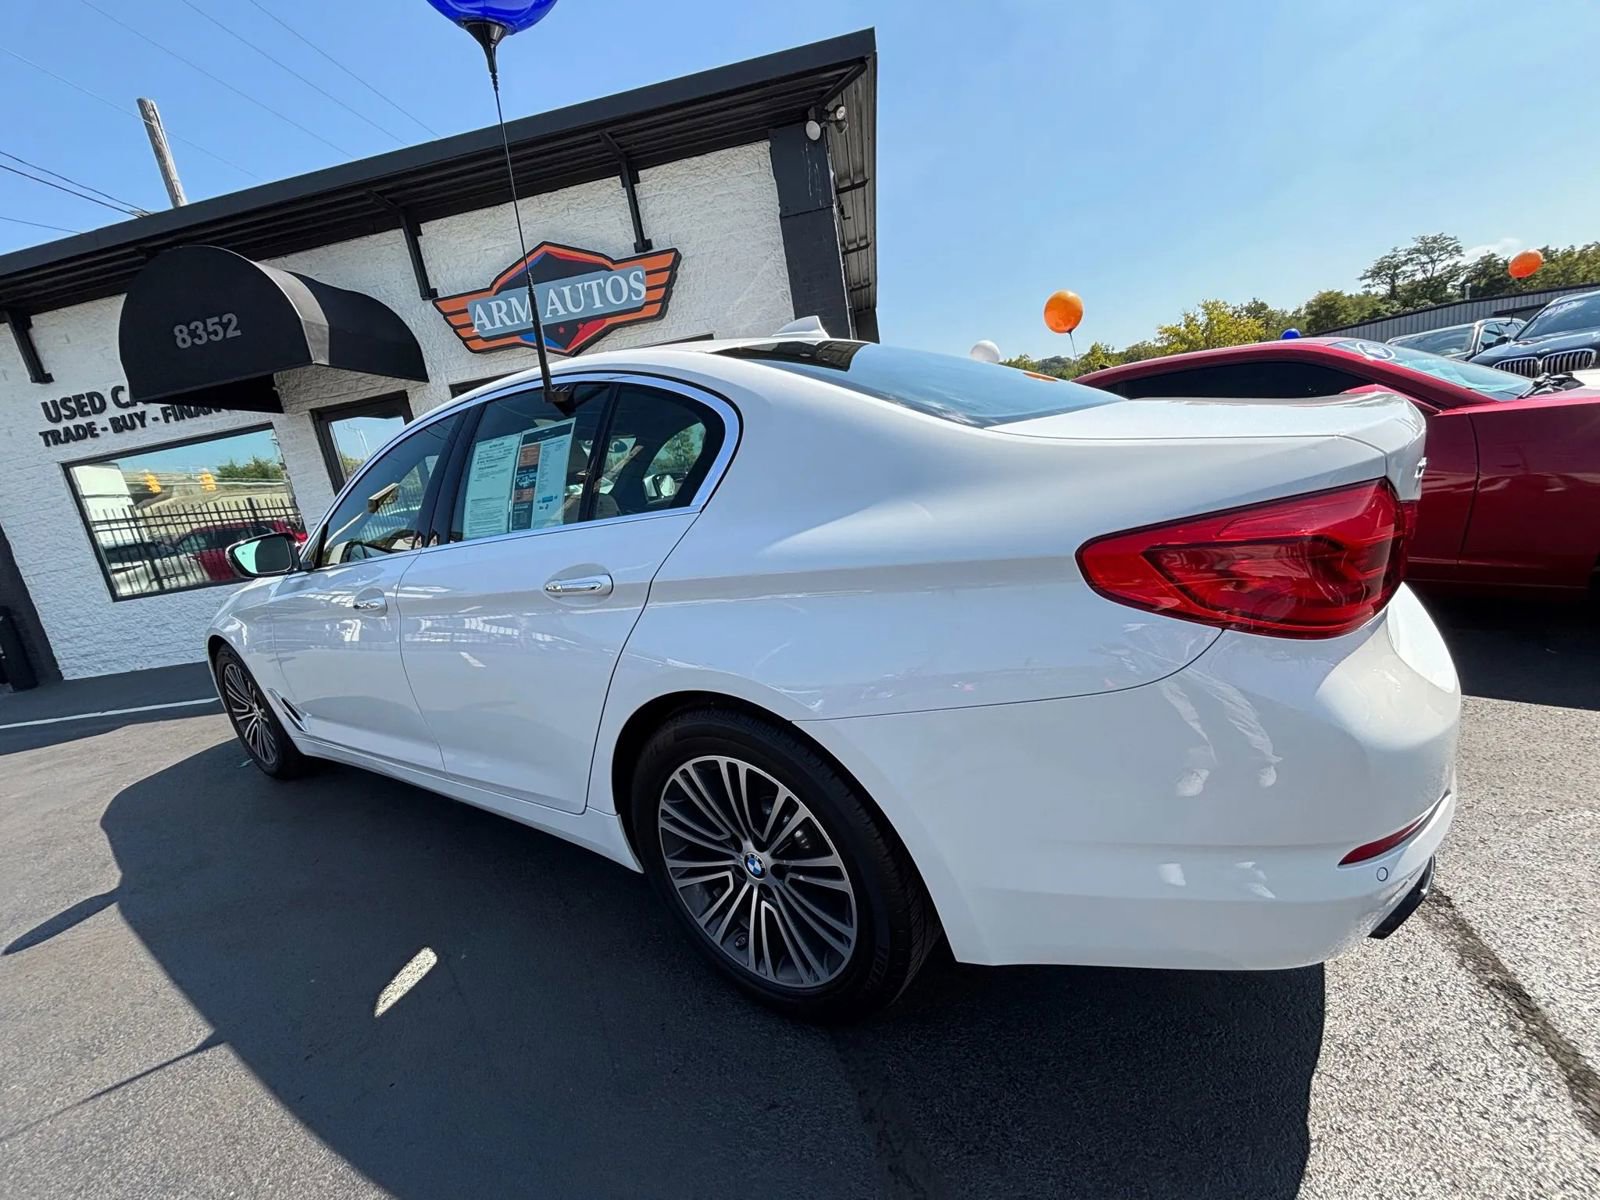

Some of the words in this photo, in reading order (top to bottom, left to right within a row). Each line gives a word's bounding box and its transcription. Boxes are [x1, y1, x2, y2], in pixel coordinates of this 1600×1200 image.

[471, 294, 538, 333] ARM
[544, 271, 646, 318] AUTOS
[173, 313, 241, 348] 8352
[41, 391, 107, 423] USED
[39, 421, 99, 447] TRADE
[108, 411, 147, 434] BUY
